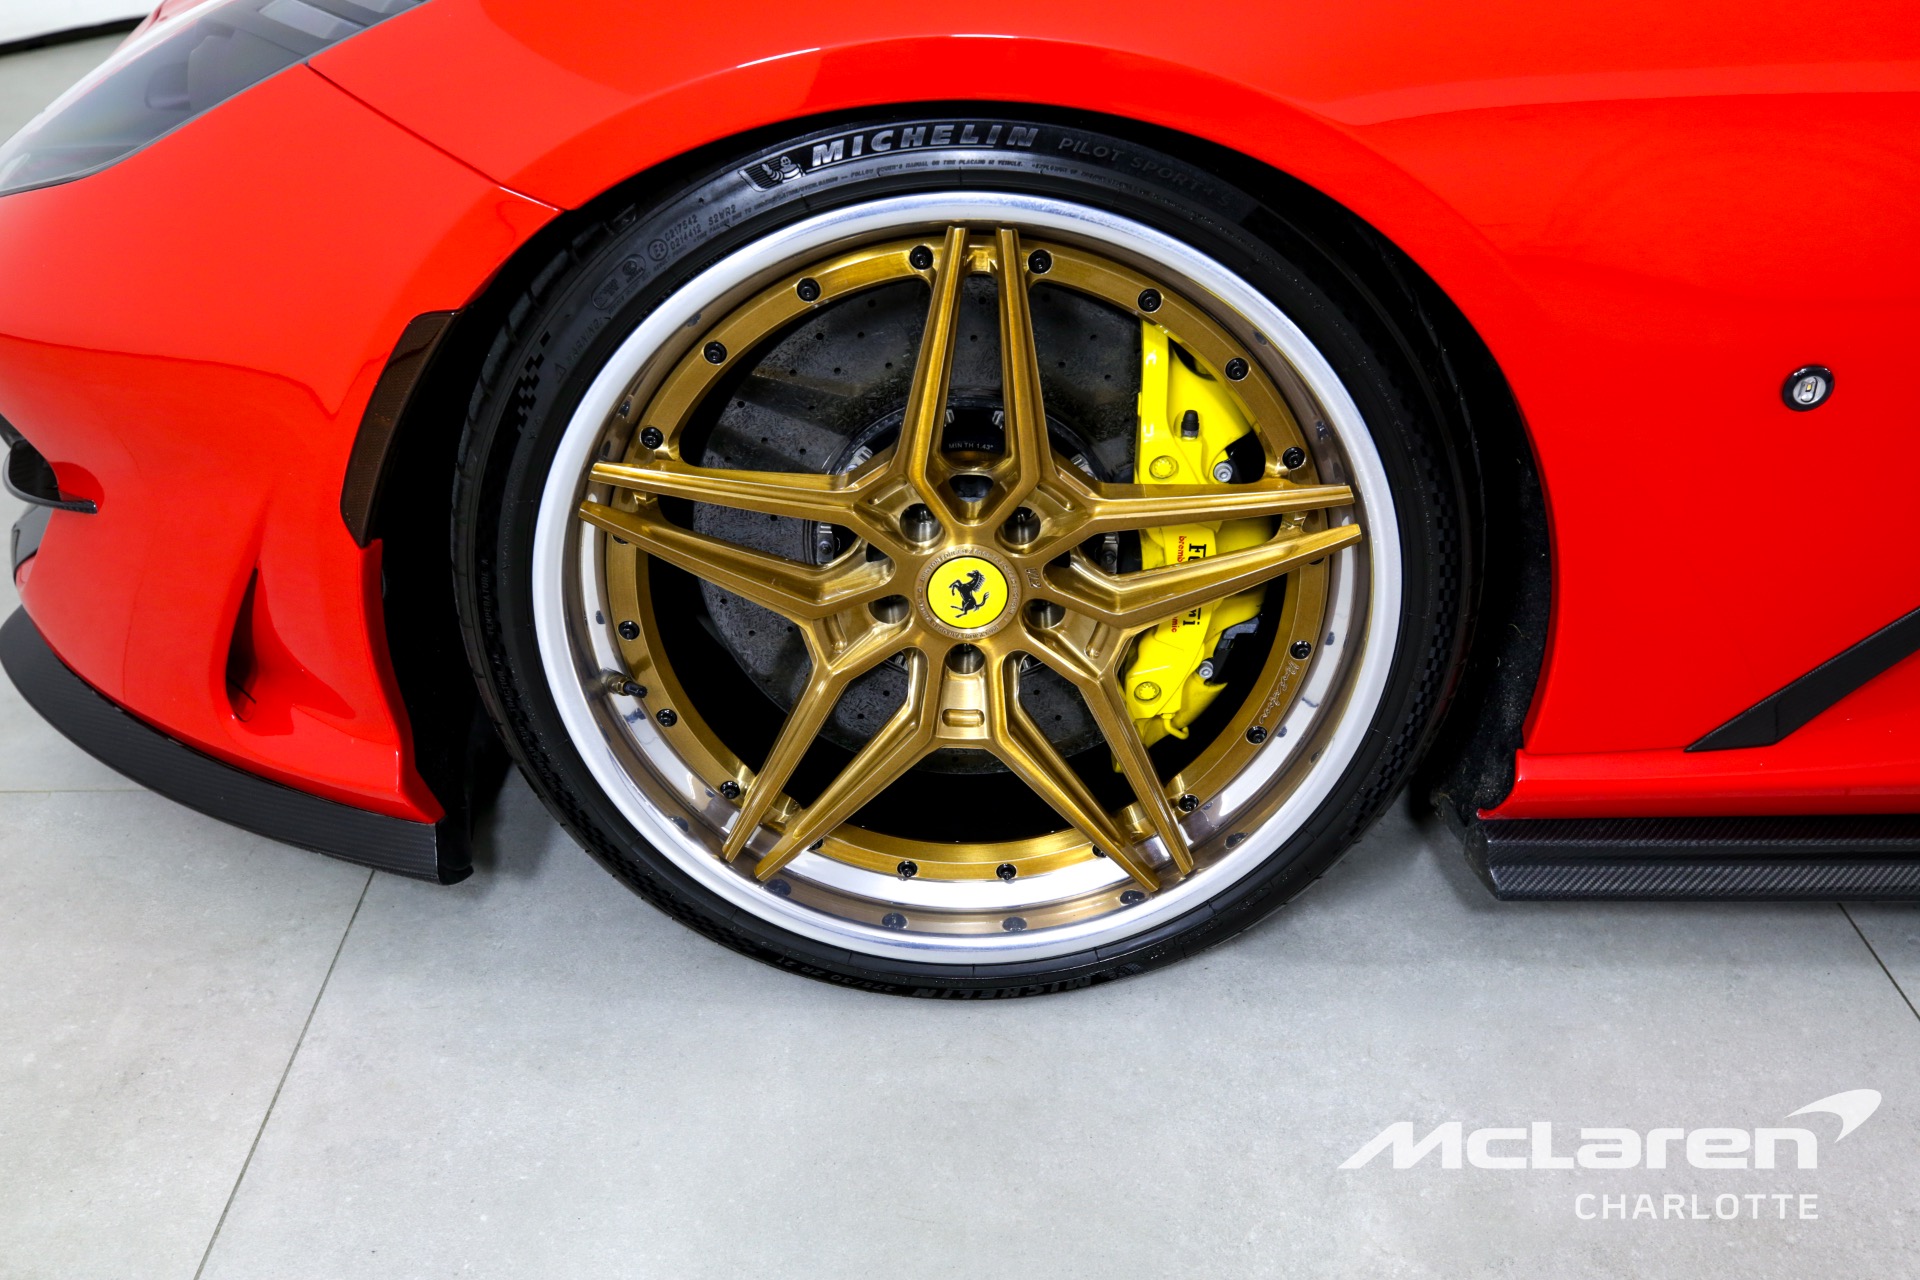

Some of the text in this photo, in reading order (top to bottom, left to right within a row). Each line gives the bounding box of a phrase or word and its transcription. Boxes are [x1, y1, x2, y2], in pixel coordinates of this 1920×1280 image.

[811, 124, 1038, 167] MICHELIN
[1058, 137, 1125, 163] PILOT
[1129, 154, 1204, 193] SPORT
[1177, 535, 1187, 564] bremb
[480, 570, 494, 635] TEMPERATURE
[911, 976, 1092, 998] MICHELIN
